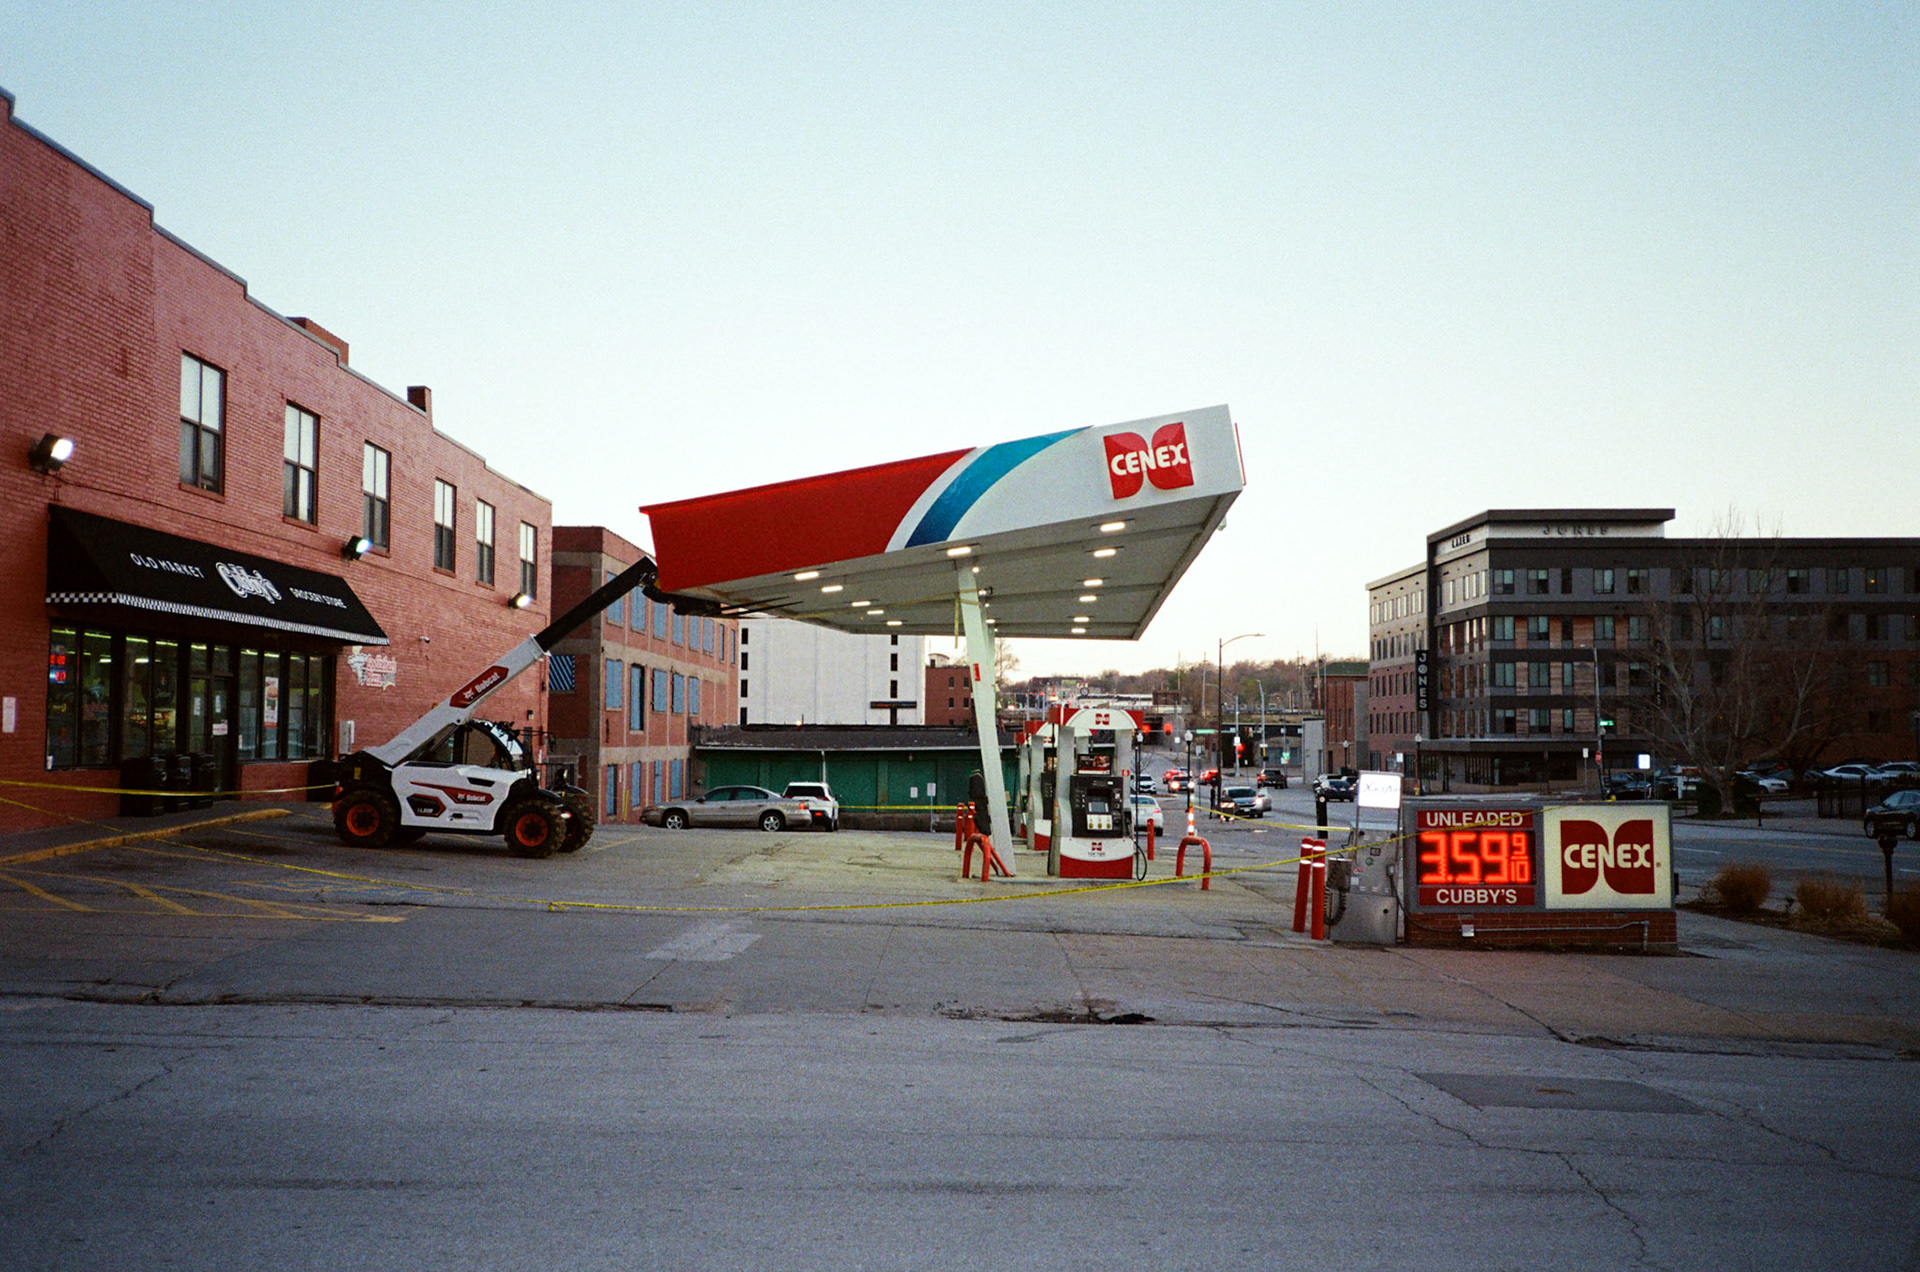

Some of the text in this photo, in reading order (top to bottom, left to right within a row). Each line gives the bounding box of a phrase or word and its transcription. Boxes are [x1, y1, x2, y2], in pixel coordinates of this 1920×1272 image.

[1110, 442, 1188, 476] CENEX
[130, 552, 205, 579] OLD MARKET
[474, 671, 501, 694] Bobcat
[1417, 653, 1429, 709] JONES
[466, 794, 487, 803] Bobcat
[1426, 812, 1524, 827] UNLEADED
[1420, 831, 1510, 884] 3.59
[1563, 843, 1652, 869] CENEX
[1436, 889, 1517, 904] CUBBY'S
